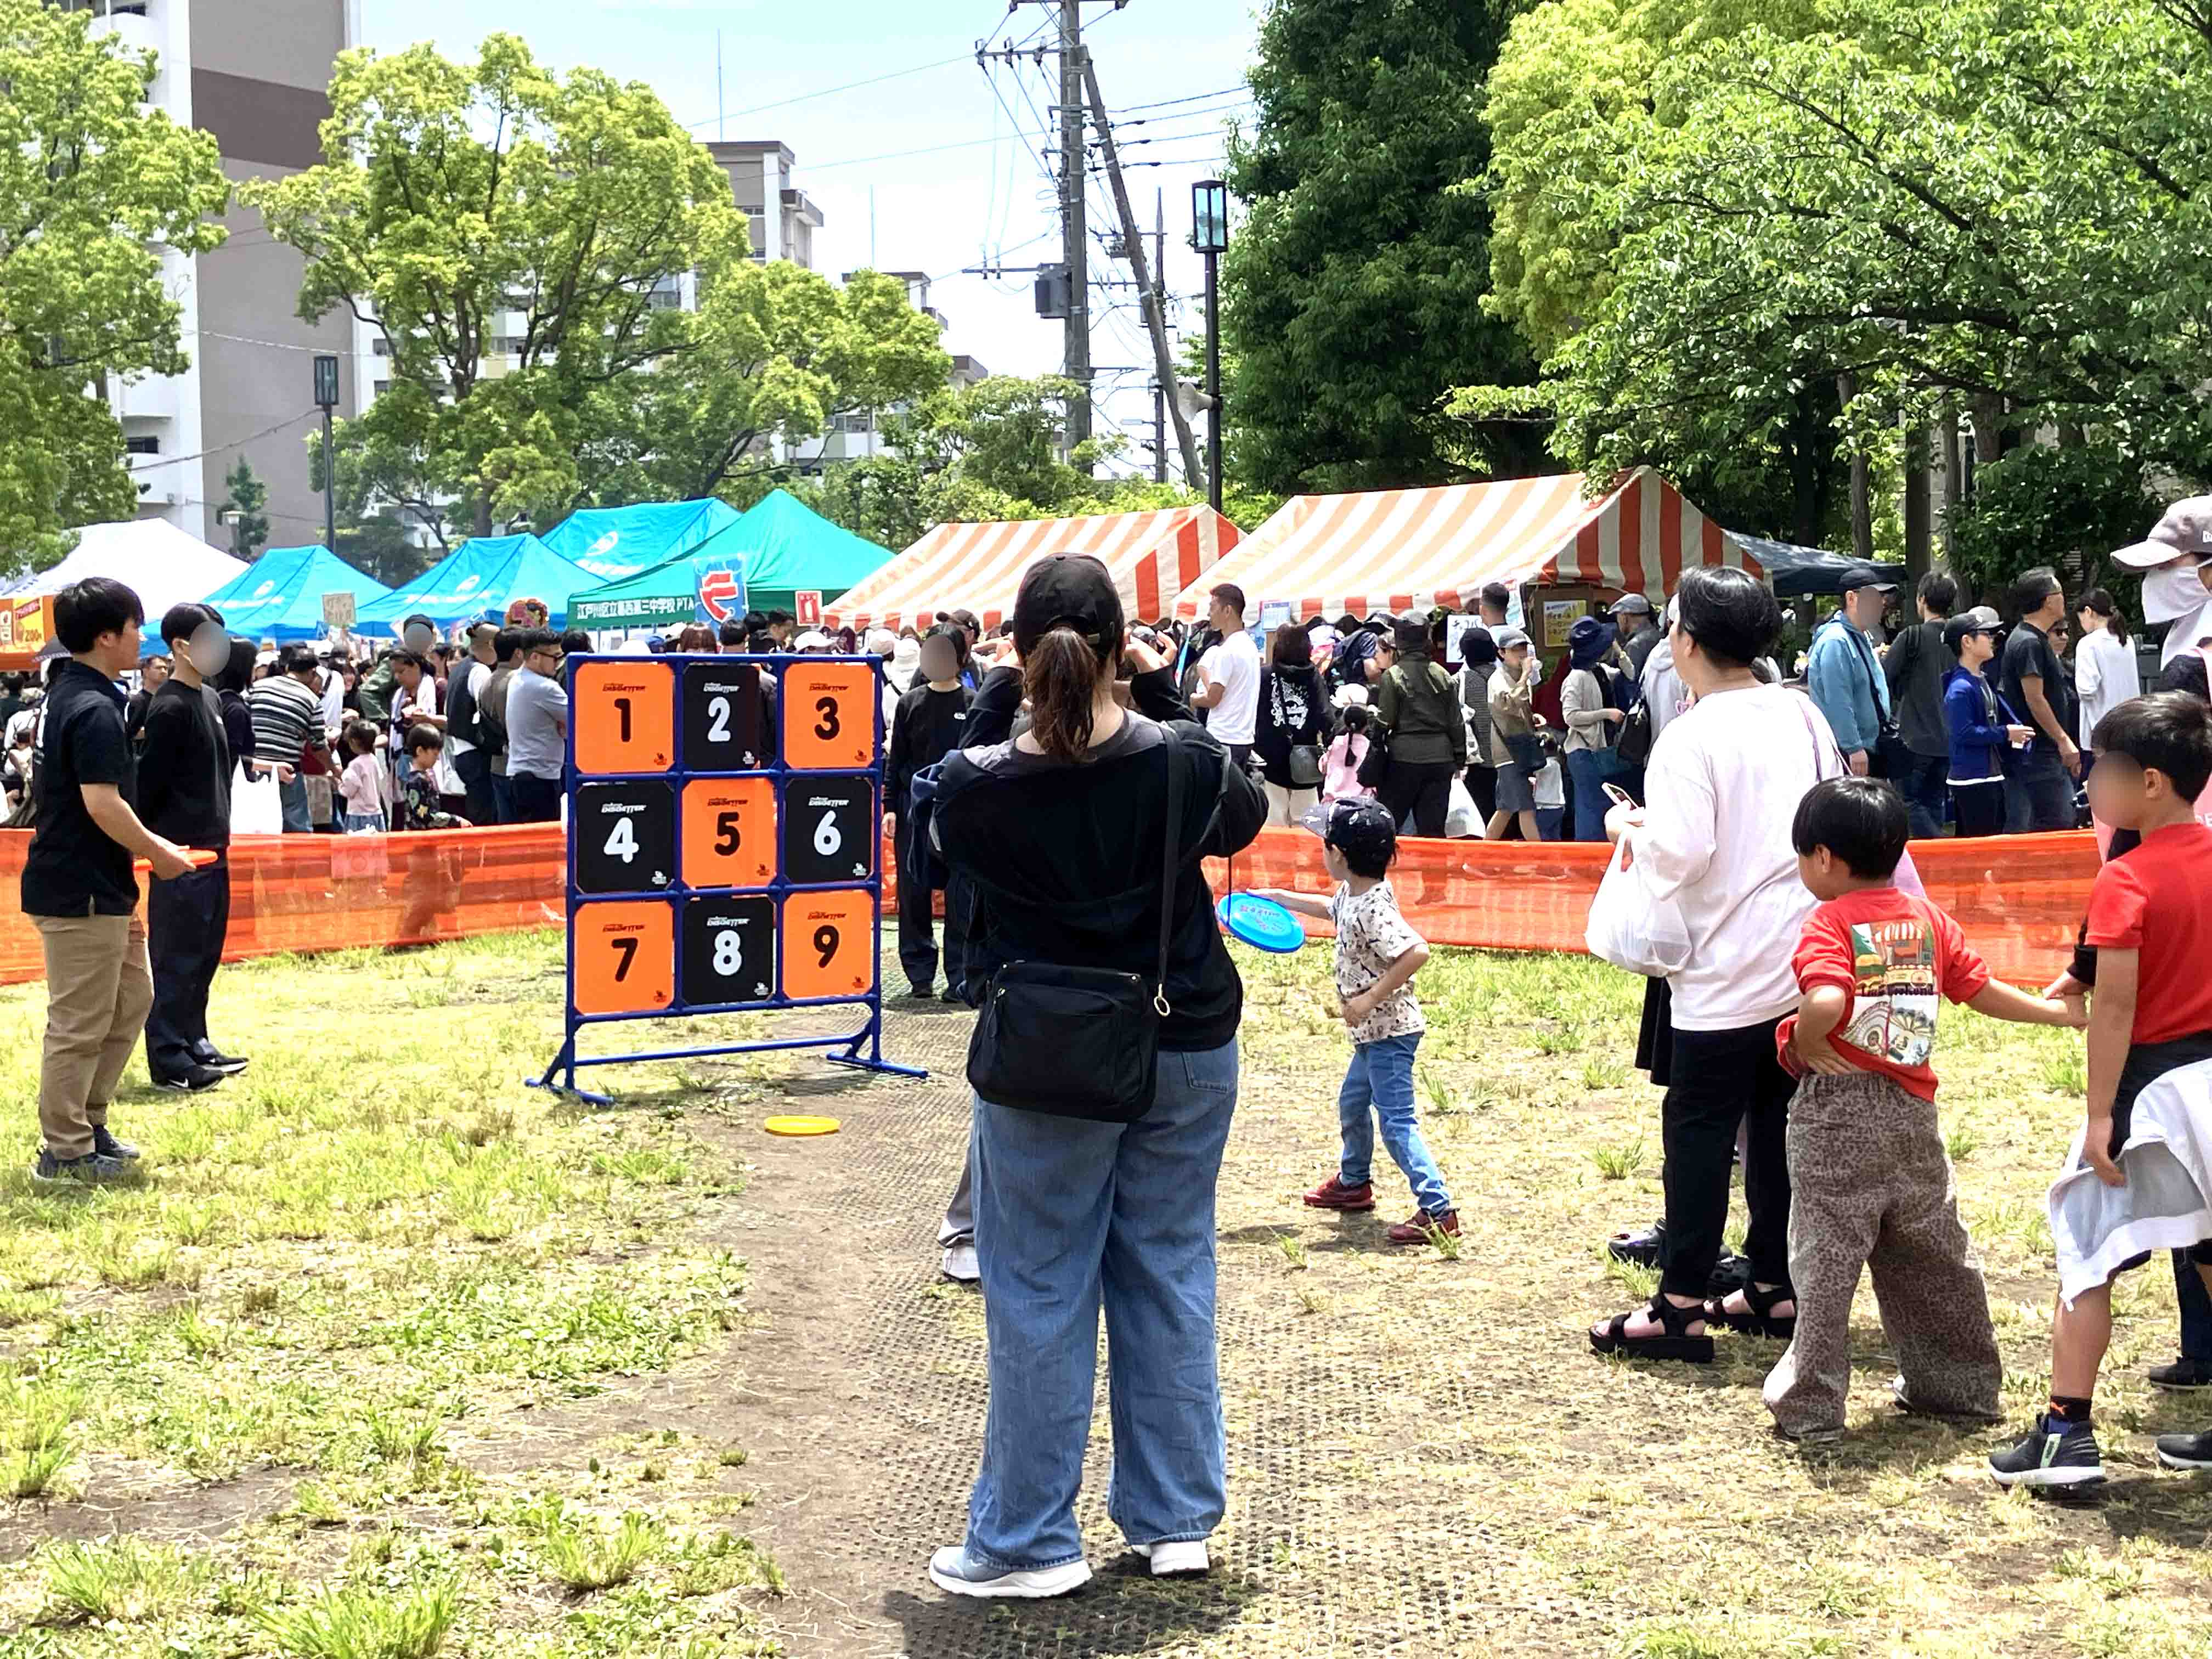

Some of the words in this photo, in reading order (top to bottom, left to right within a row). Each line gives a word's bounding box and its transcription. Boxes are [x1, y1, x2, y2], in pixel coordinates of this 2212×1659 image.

[677, 597, 694, 611] PTA
[614, 698, 631, 742] 1
[708, 697, 730, 742] 2
[815, 697, 839, 740] 3
[604, 817, 639, 863] 4
[714, 812, 740, 856] 5
[814, 810, 841, 855] 6
[612, 938, 638, 982] 7
[713, 930, 742, 975] 8
[814, 925, 839, 968] 9
